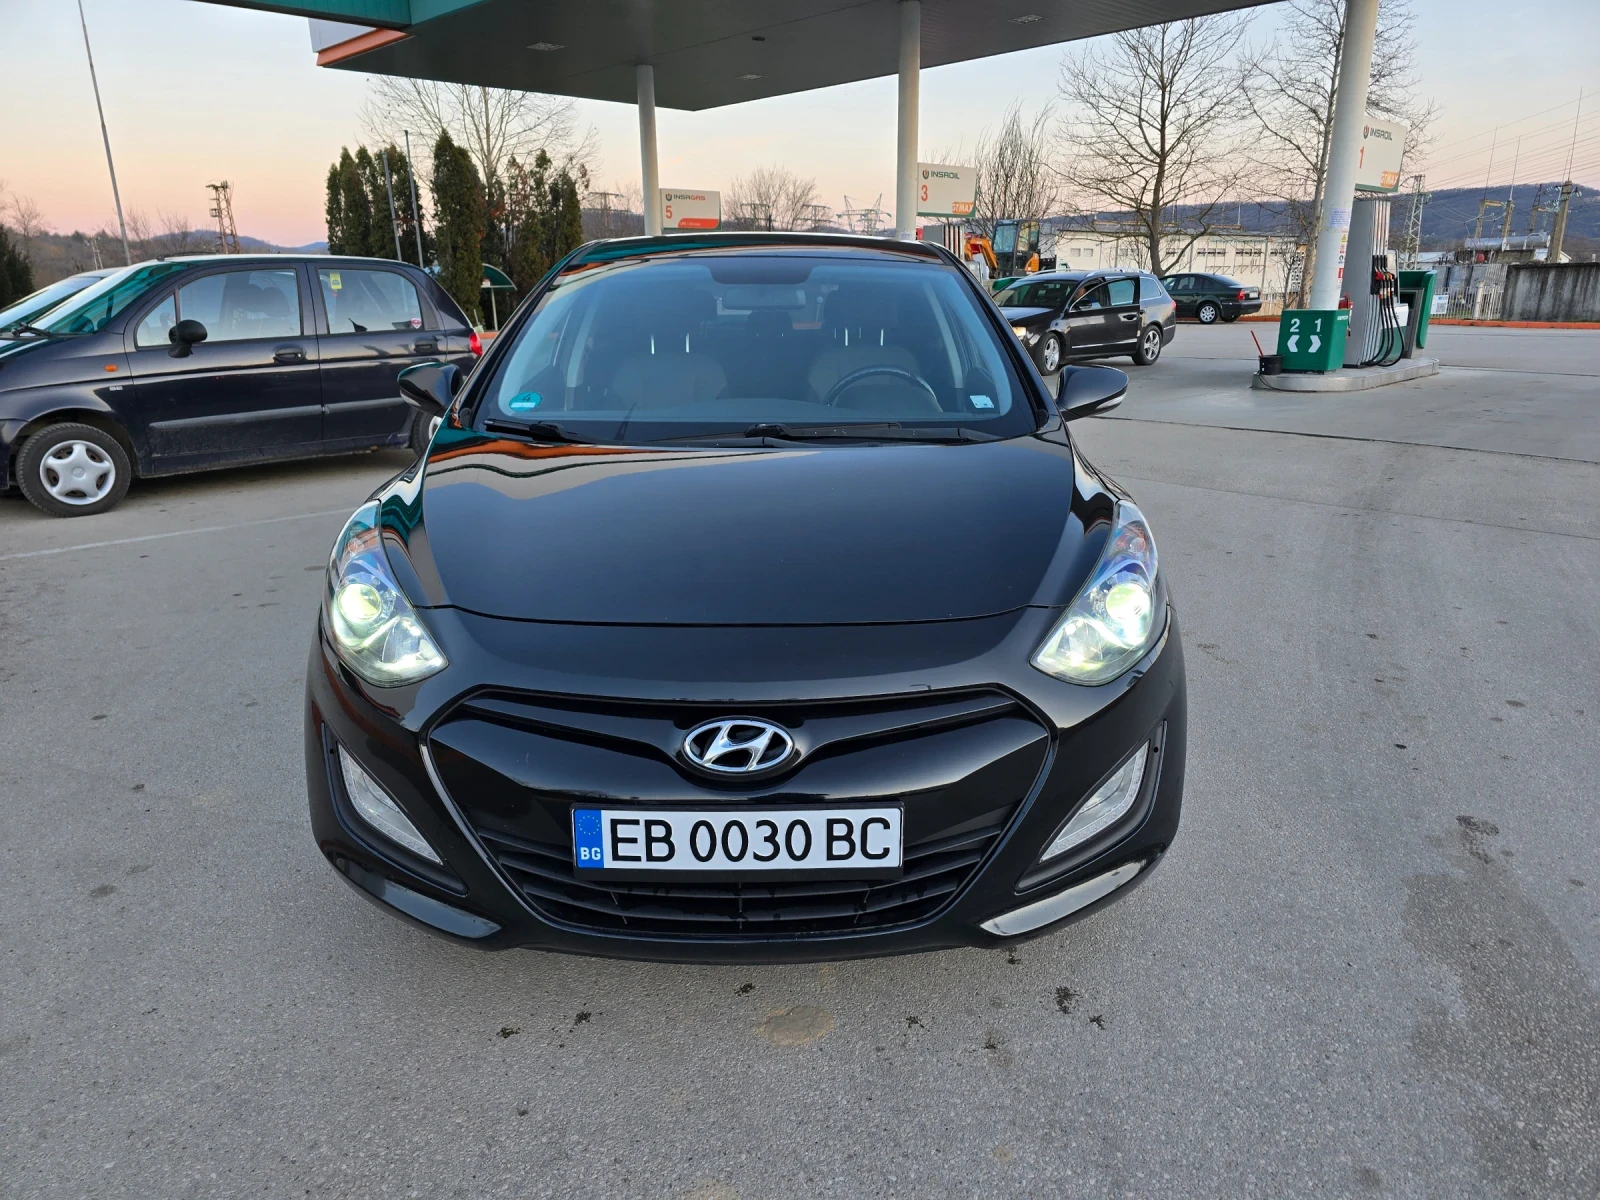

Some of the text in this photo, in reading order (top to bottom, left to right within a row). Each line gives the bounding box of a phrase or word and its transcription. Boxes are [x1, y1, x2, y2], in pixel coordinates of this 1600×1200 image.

[1370, 127, 1392, 140] INSAOIL
[1360, 146, 1364, 168] 1
[930, 170, 960, 179] INSAOIL
[921, 185, 928, 201] 3
[666, 205, 672, 218] 5
[1289, 318, 1322, 333] 2 1
[609, 817, 891, 863] EB 0030 BC
[580, 847, 601, 861] BG
